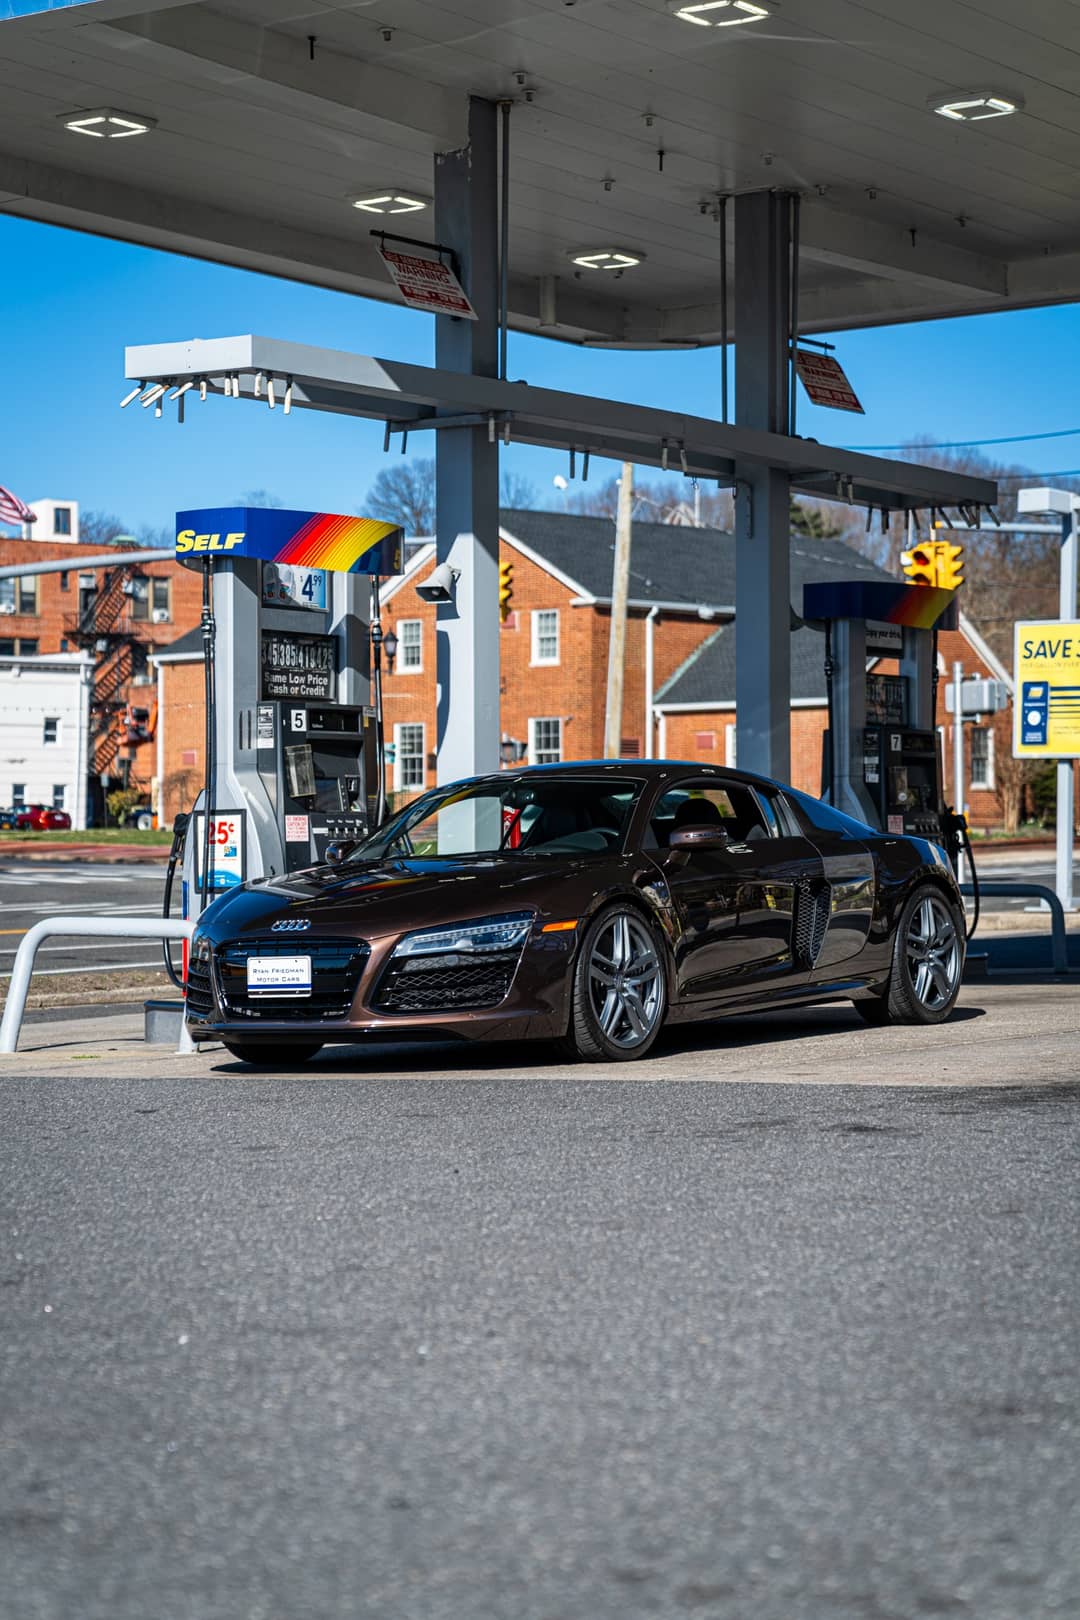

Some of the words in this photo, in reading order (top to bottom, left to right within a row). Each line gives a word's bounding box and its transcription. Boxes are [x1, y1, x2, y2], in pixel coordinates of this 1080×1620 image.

[393, 262, 449, 284] WARNING
[176, 529, 246, 553] SELF
[1022, 639, 1072, 659] SAVE
[264, 672, 288, 683] Same
[288, 673, 305, 685] Low
[307, 674, 329, 686] Price
[268, 684, 288, 695] Cash
[290, 687, 300, 695] or
[300, 685, 326, 697] Credit
[294, 712, 304, 729] 5
[892, 736, 900, 748] 7
